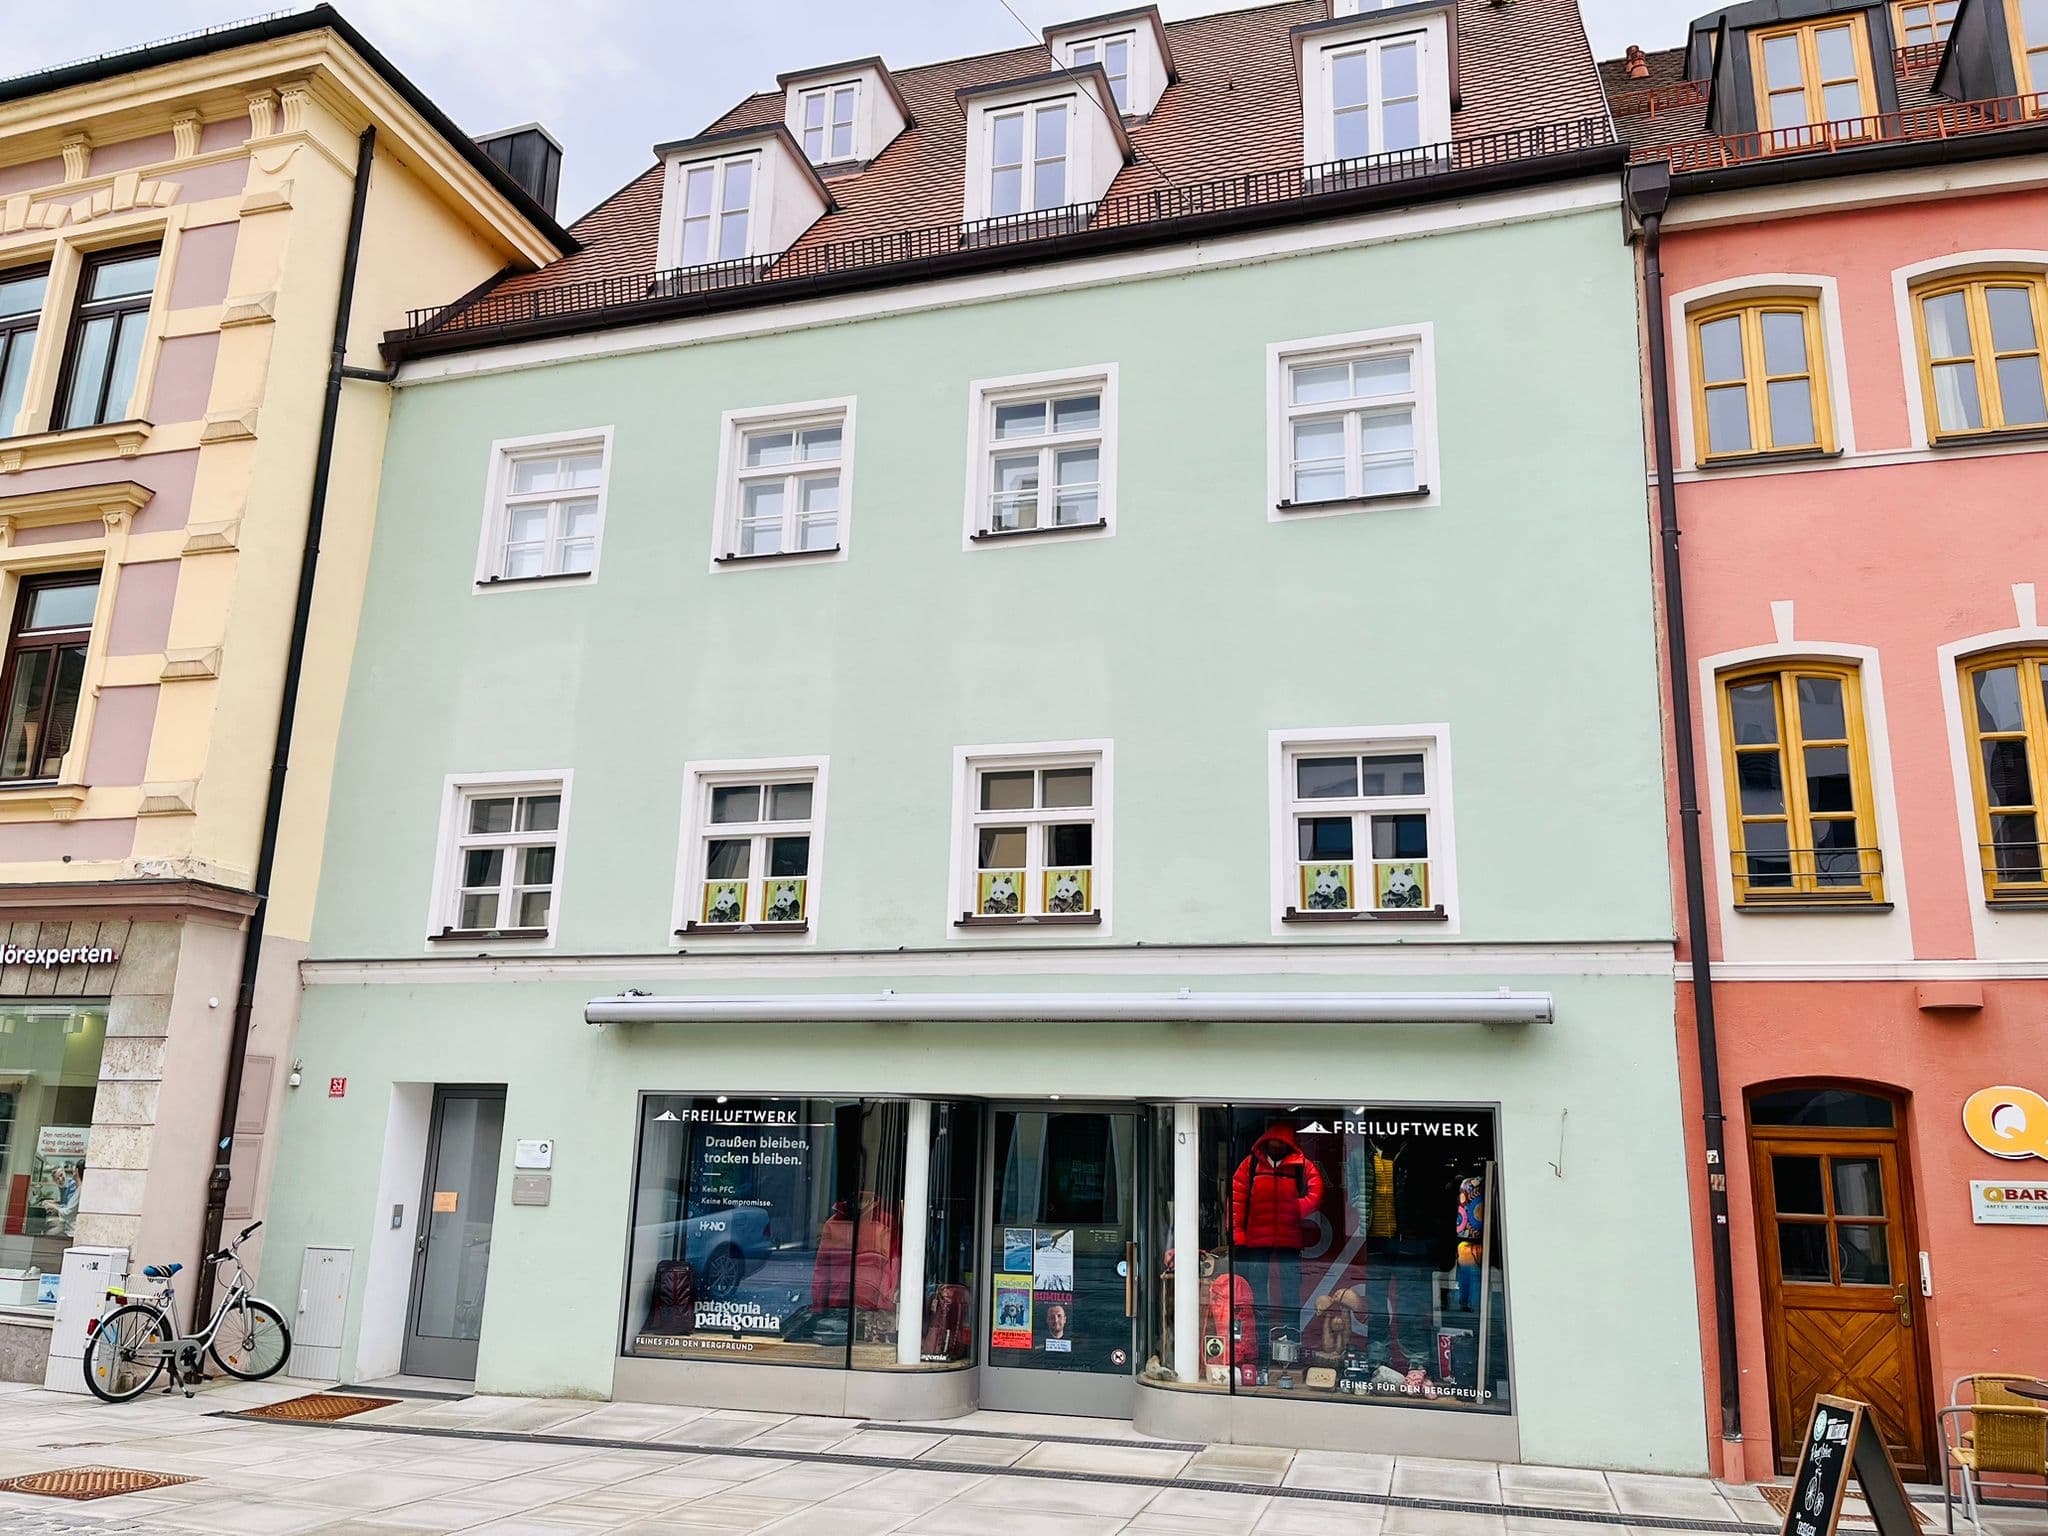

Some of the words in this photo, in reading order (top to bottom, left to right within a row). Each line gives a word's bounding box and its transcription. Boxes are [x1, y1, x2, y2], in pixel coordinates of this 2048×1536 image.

[332, 1079, 343, 1091] 53
[682, 1110, 797, 1123] FREILUFTWERK
[1333, 1121, 1480, 1137] FREILUFTWERK
[705, 1136, 757, 1149] Draußen
[759, 1136, 810, 1151] bleiben,
[704, 1153, 749, 1164] trocken
[752, 1153, 802, 1166] bleiben.
[720, 1186, 736, 1194] PFC.
[723, 1198, 774, 1207] Kompromisse.
[694, 1300, 760, 1315] patagonia
[695, 1312, 780, 1331] patagonia
[636, 1337, 662, 1346] FEINES
[664, 1338, 680, 1347] FÜR
[701, 1341, 754, 1351] BERGFREUND
[1340, 1380, 1373, 1391] FEINES
[1377, 1381, 1396, 1392] FÜR
[1400, 1384, 1420, 1393] DEN
[1424, 1387, 1492, 1399] BERGFREUND
